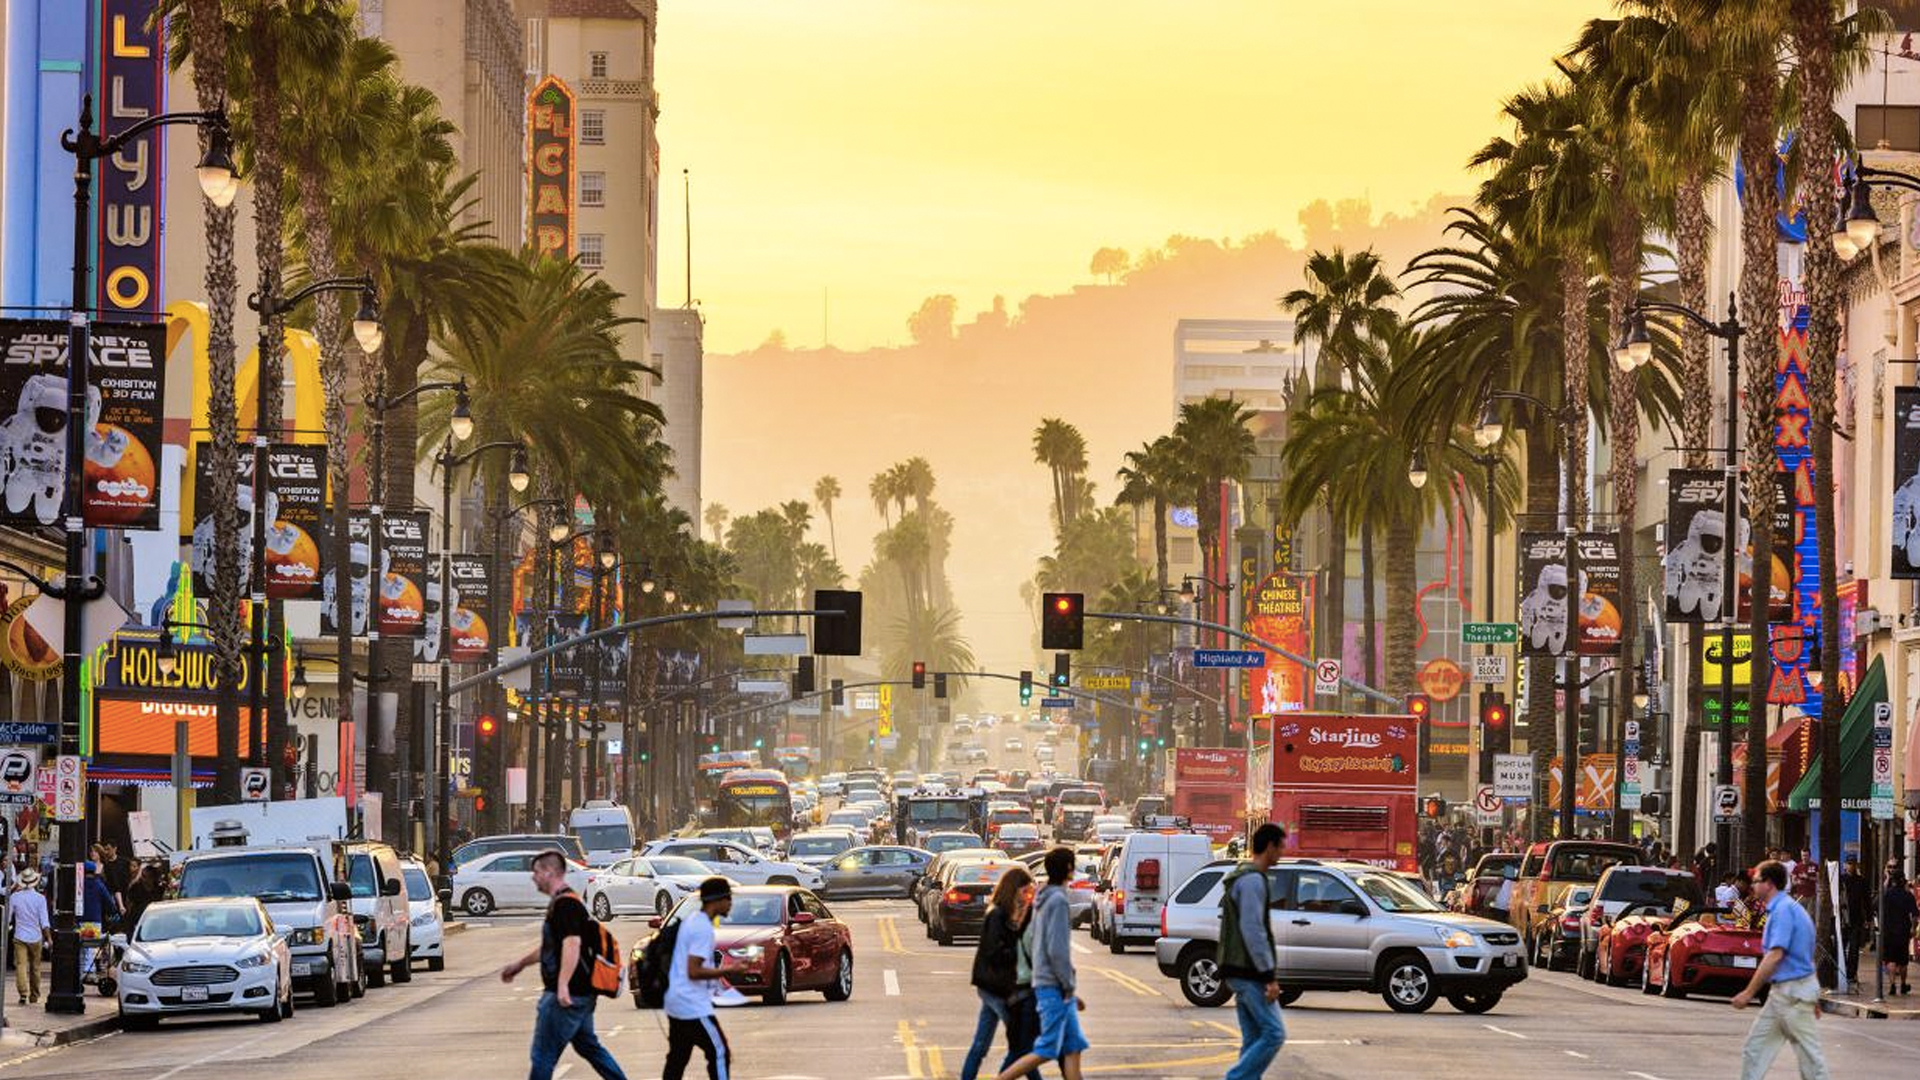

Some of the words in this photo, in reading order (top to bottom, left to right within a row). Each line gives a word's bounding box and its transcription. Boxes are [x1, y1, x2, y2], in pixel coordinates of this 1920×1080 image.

[535, 105, 570, 137] EL
[11, 334, 131, 347] JOURNEY
[4, 345, 153, 368] SPACE
[101, 378, 156, 389] EXHIBITION
[1775, 326, 1811, 449] WAX
[112, 390, 128, 398] 3D
[131, 391, 155, 399] FILM
[1529, 548, 1617, 559] SPACE
[1271, 577, 1287, 588] TCL
[1261, 589, 1297, 600] CHINESE
[1258, 602, 1301, 614] THEATRES
[1200, 654, 1242, 665] Highland
[1247, 654, 1258, 663] Av
[1478, 667, 1500, 675] BLOCK
